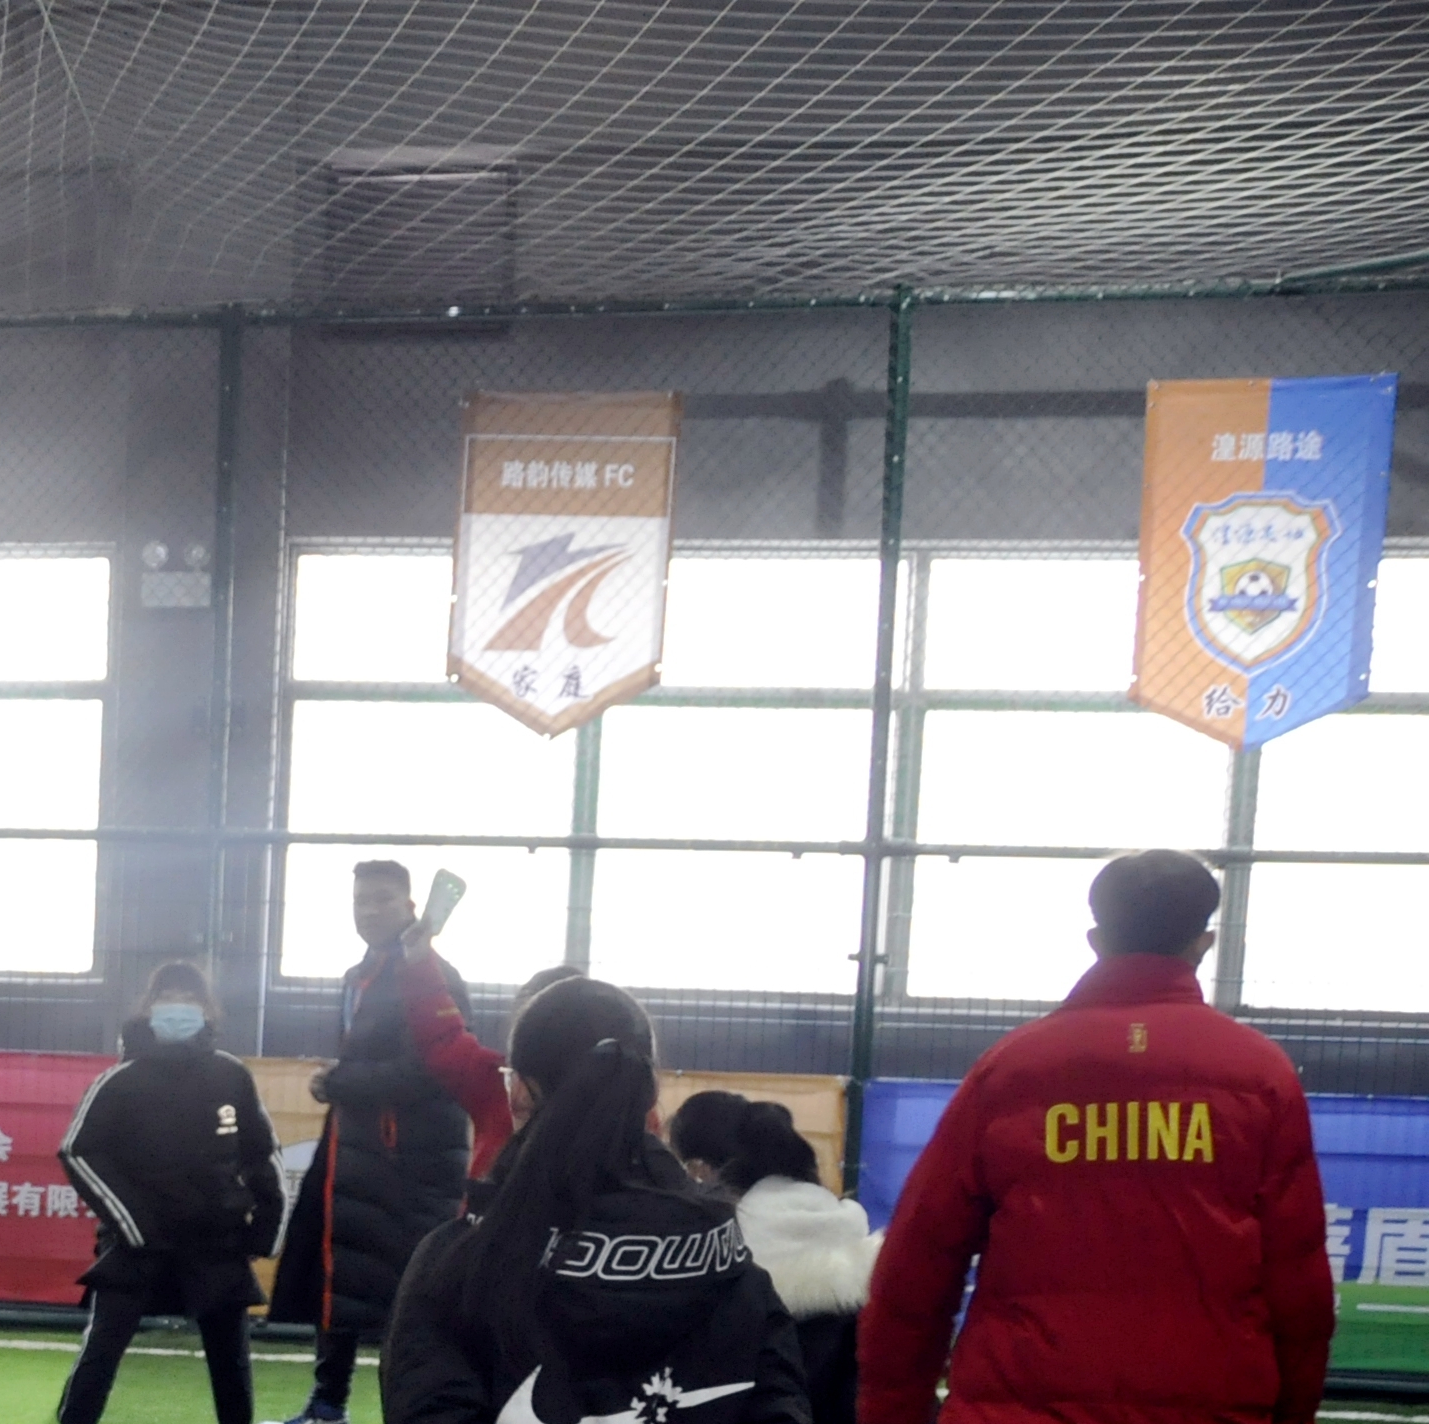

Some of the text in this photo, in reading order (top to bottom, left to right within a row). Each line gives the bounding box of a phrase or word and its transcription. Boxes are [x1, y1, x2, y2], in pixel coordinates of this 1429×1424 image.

[1211, 430, 1323, 461] 湟源路途
[604, 463, 635, 488] FC
[1204, 685, 1291, 718] 给力
[1045, 1101, 1214, 1164] CHINA
